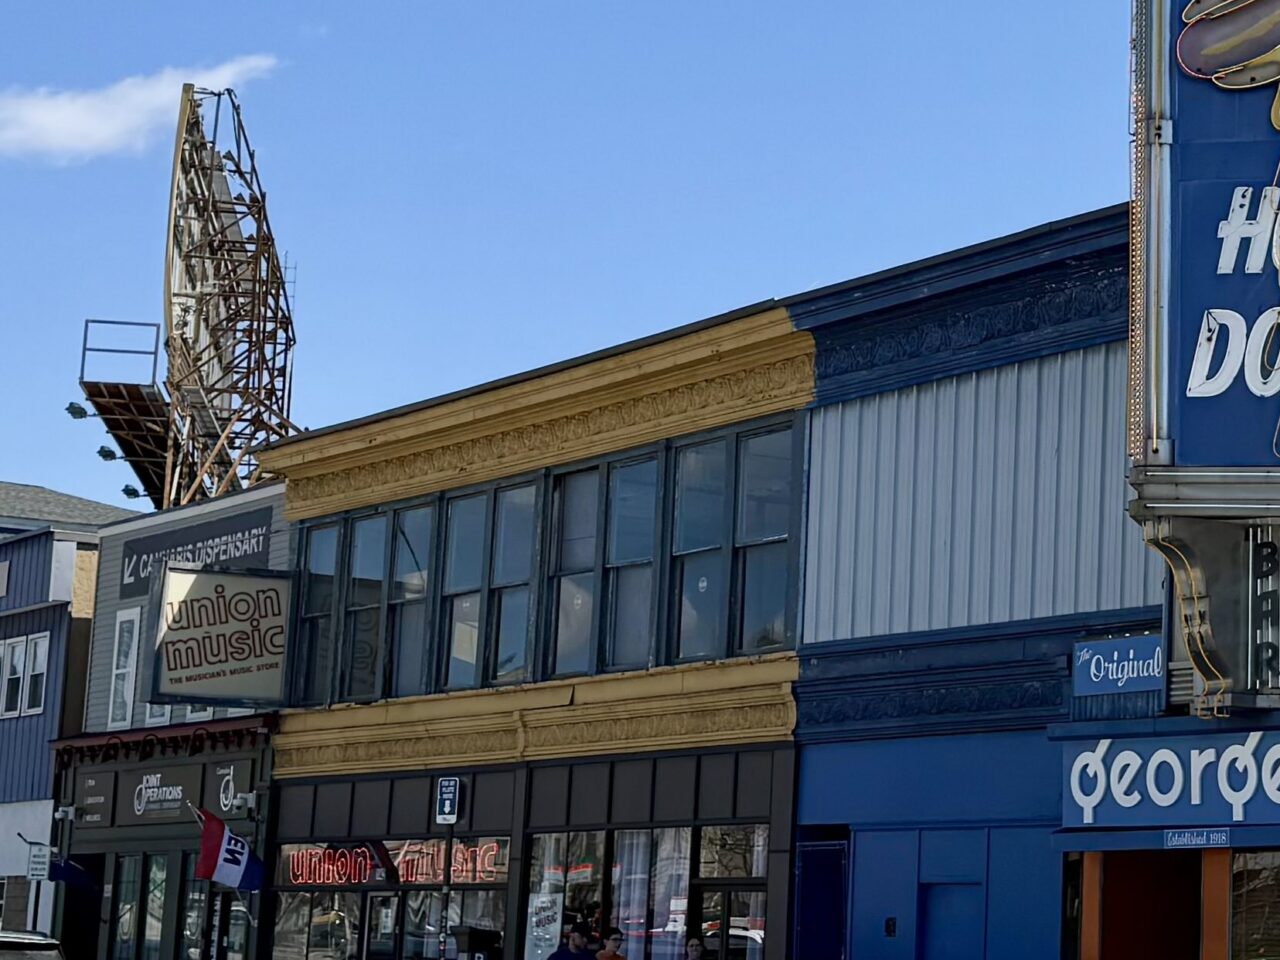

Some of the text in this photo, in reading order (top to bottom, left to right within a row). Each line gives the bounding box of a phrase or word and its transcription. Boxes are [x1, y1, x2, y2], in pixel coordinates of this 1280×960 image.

[195, 526, 267, 565] DISPENSARY
[166, 584, 282, 632] union
[1254, 541, 1280, 678] BAR
[165, 618, 285, 672] music
[169, 661, 280, 685] THE MUSICIAN'S MUSIC STORE
[1090, 646, 1163, 687] Original
[143, 773, 161, 787] JOINT
[1210, 832, 1228, 844] 1918
[290, 846, 371, 885] union
